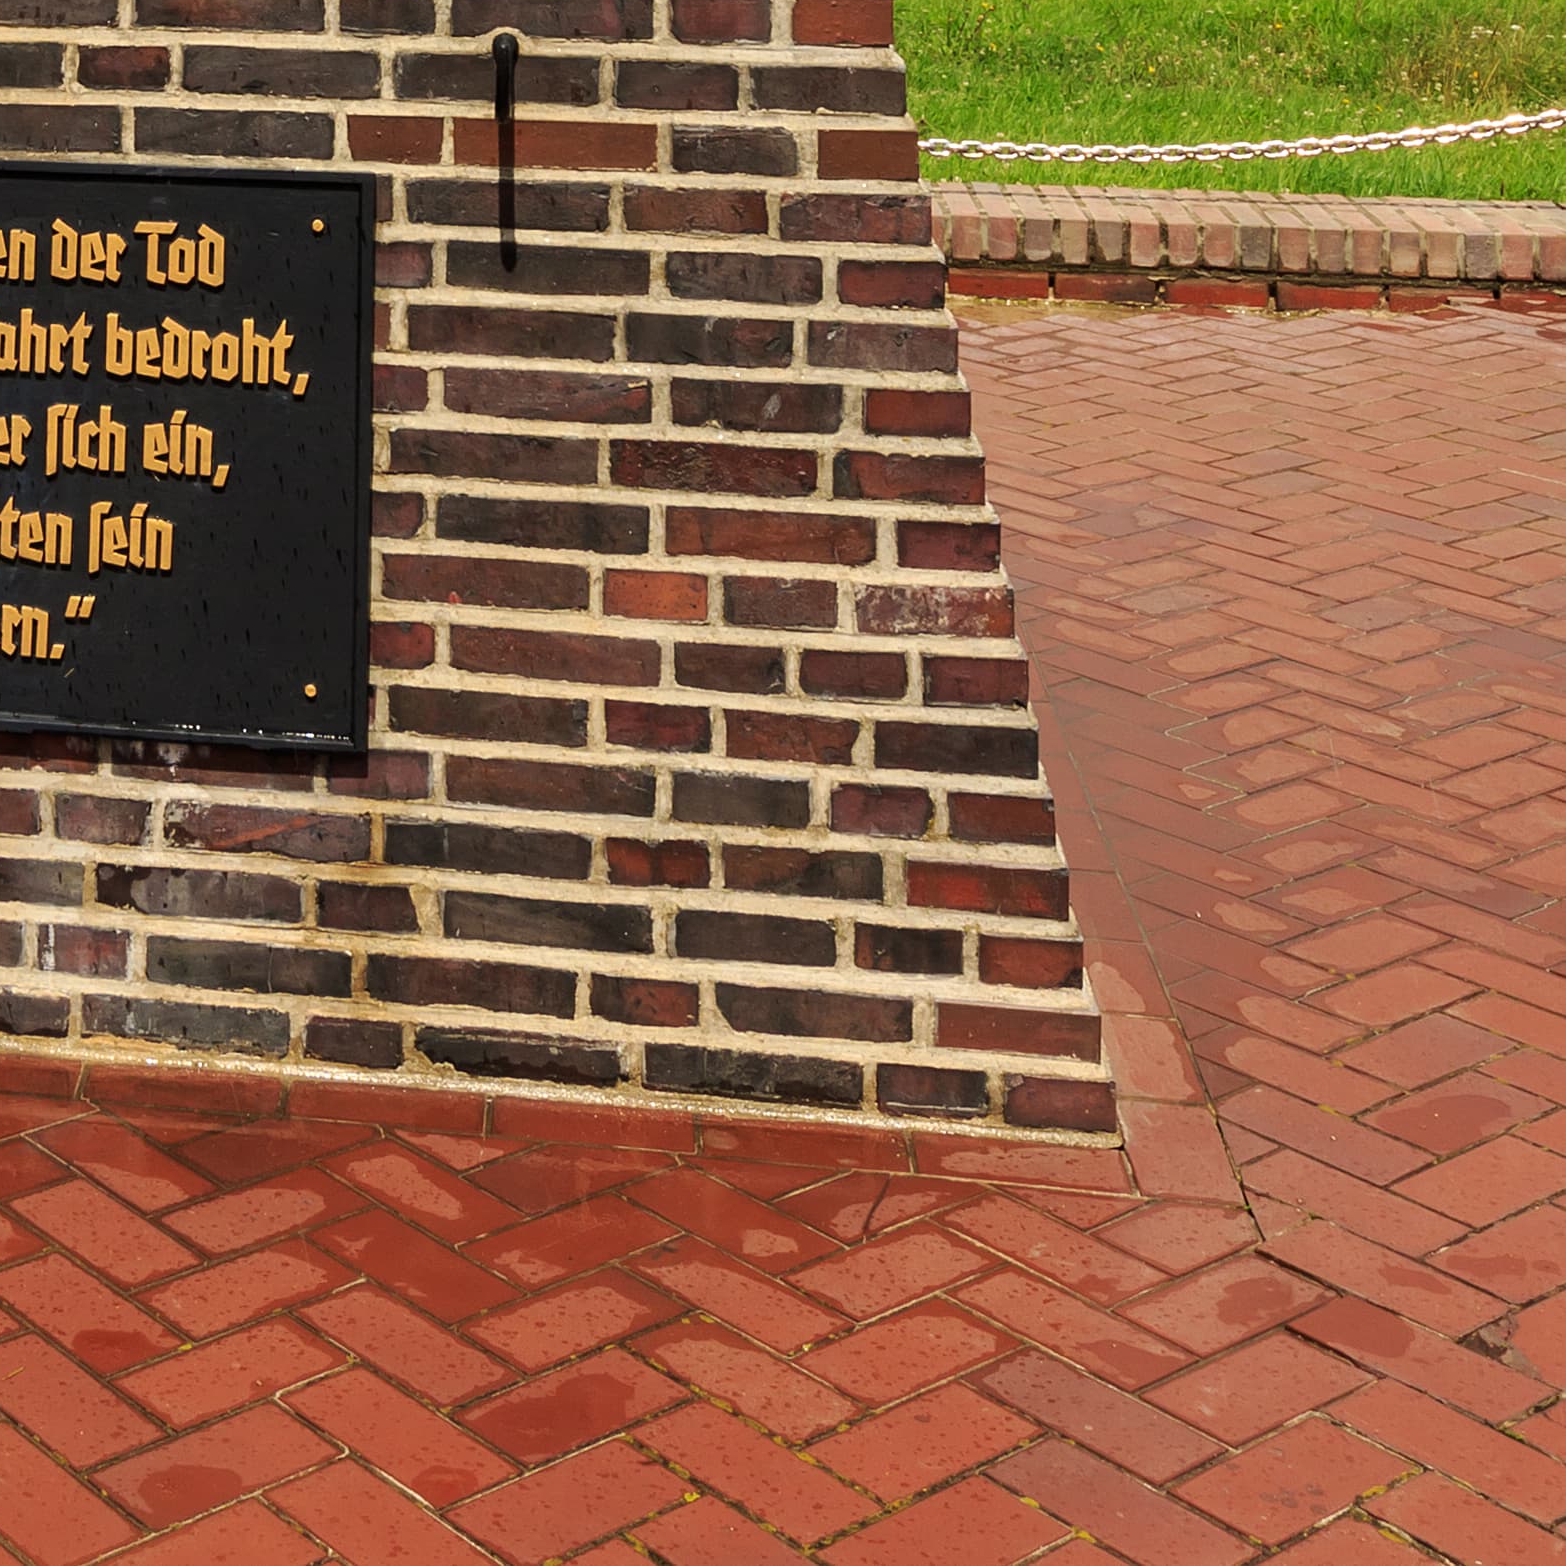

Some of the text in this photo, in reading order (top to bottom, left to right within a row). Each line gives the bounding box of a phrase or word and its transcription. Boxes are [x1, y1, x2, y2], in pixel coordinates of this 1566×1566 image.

[50, 217, 127, 282] der
[133, 219, 225, 287] Tod
[105, 312, 310, 395] bedroht,
[142, 409, 230, 487] ein,
